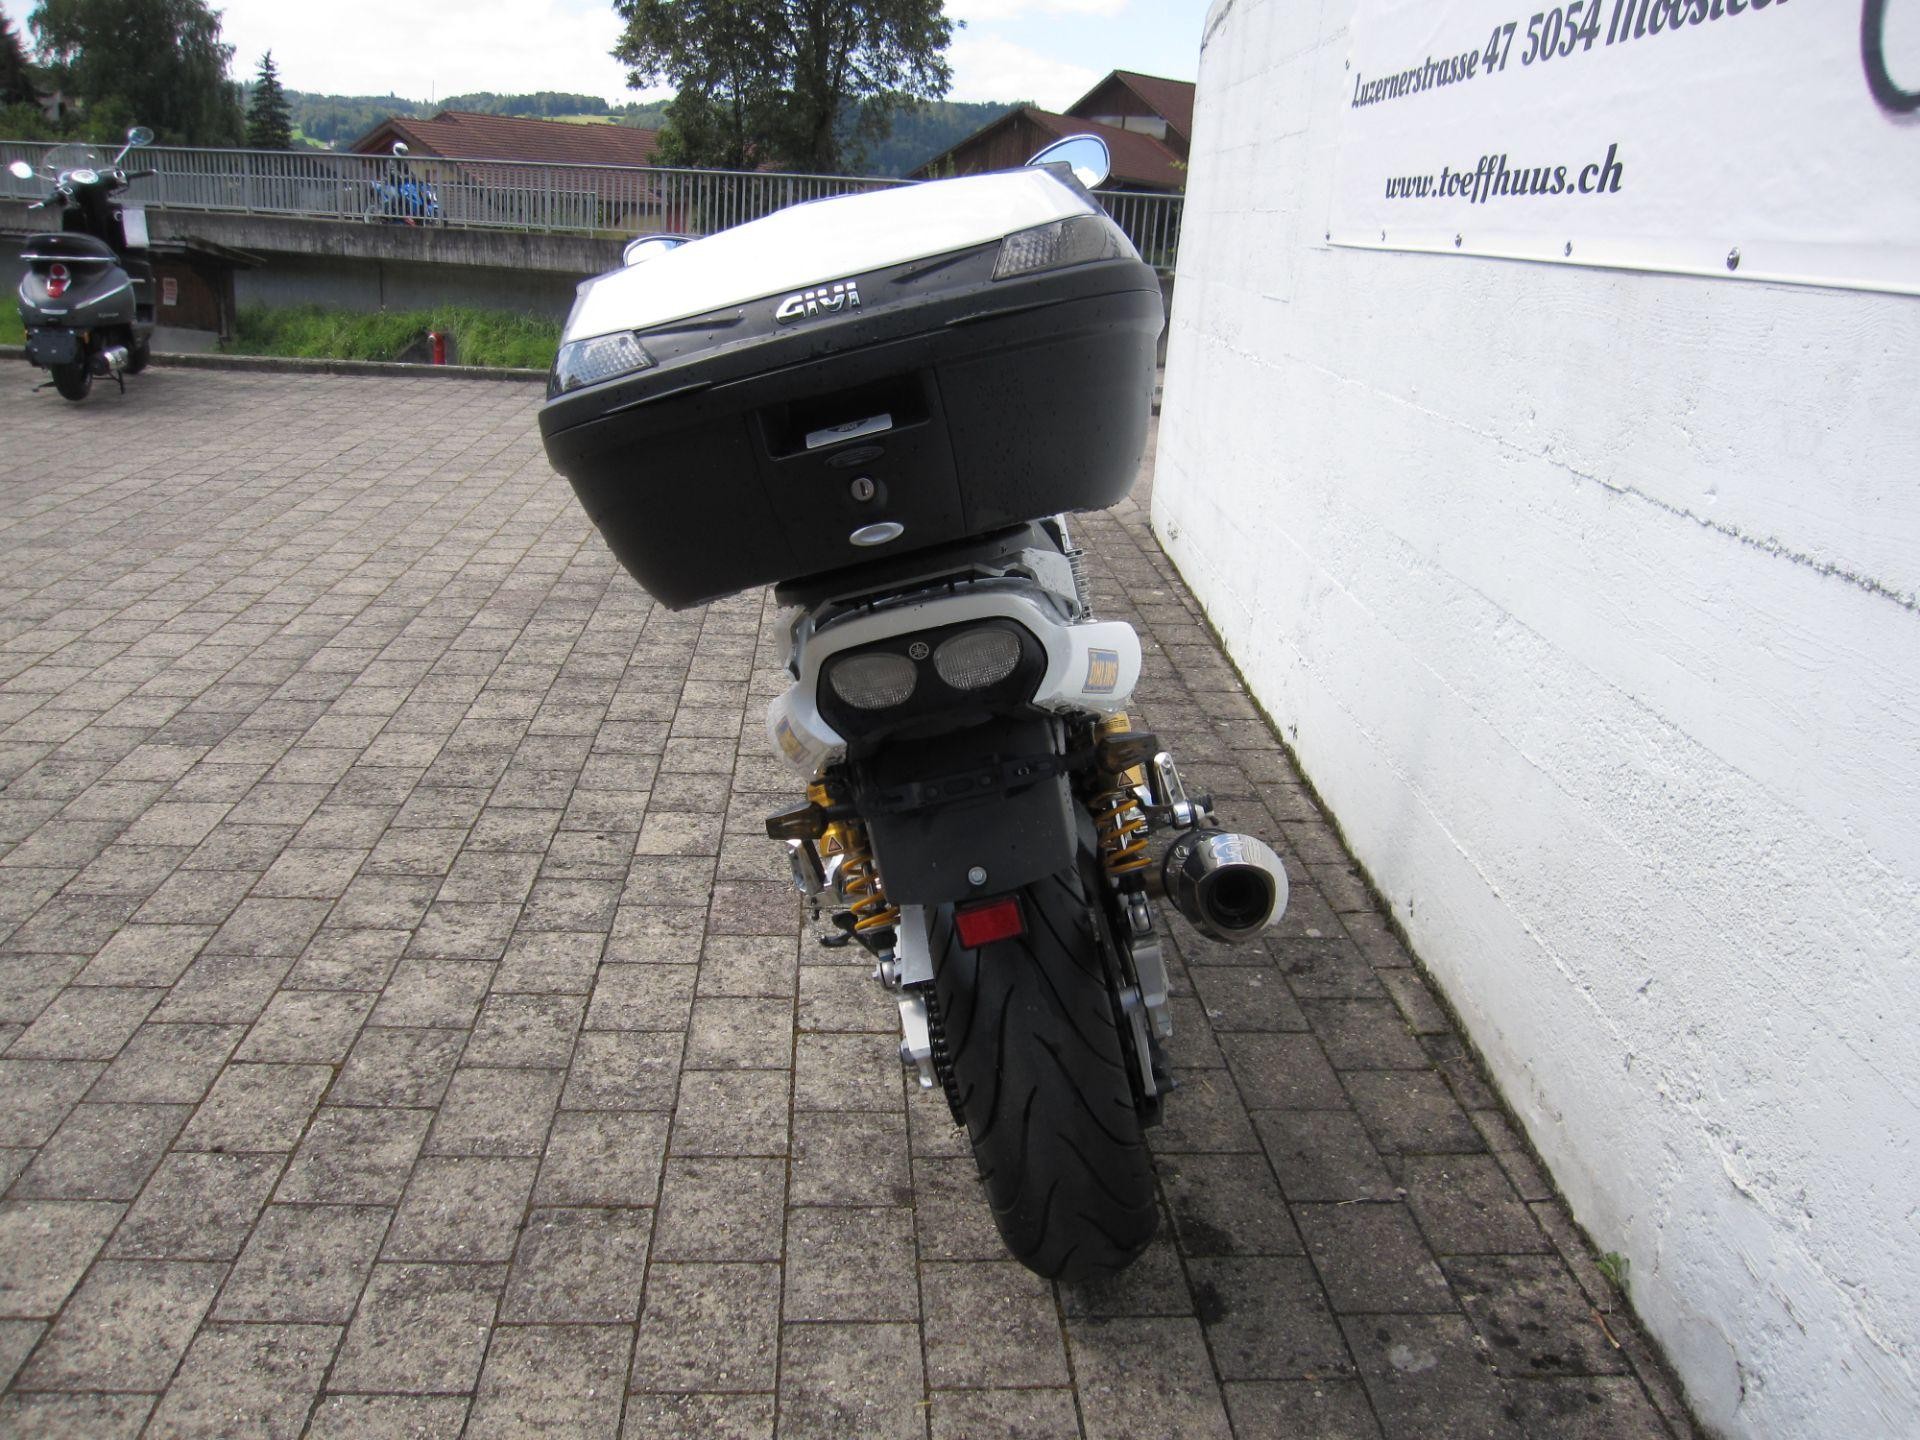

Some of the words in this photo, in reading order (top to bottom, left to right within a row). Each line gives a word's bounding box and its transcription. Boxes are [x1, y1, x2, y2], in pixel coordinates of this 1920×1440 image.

[1352, 49, 1479, 108] Luzernerstrasse
[1482, 21, 1517, 74] 47
[1522, 0, 1602, 66] 5054
[1385, 143, 1623, 204] www.toeffhuus.ch
[775, 282, 861, 325] GIVI
